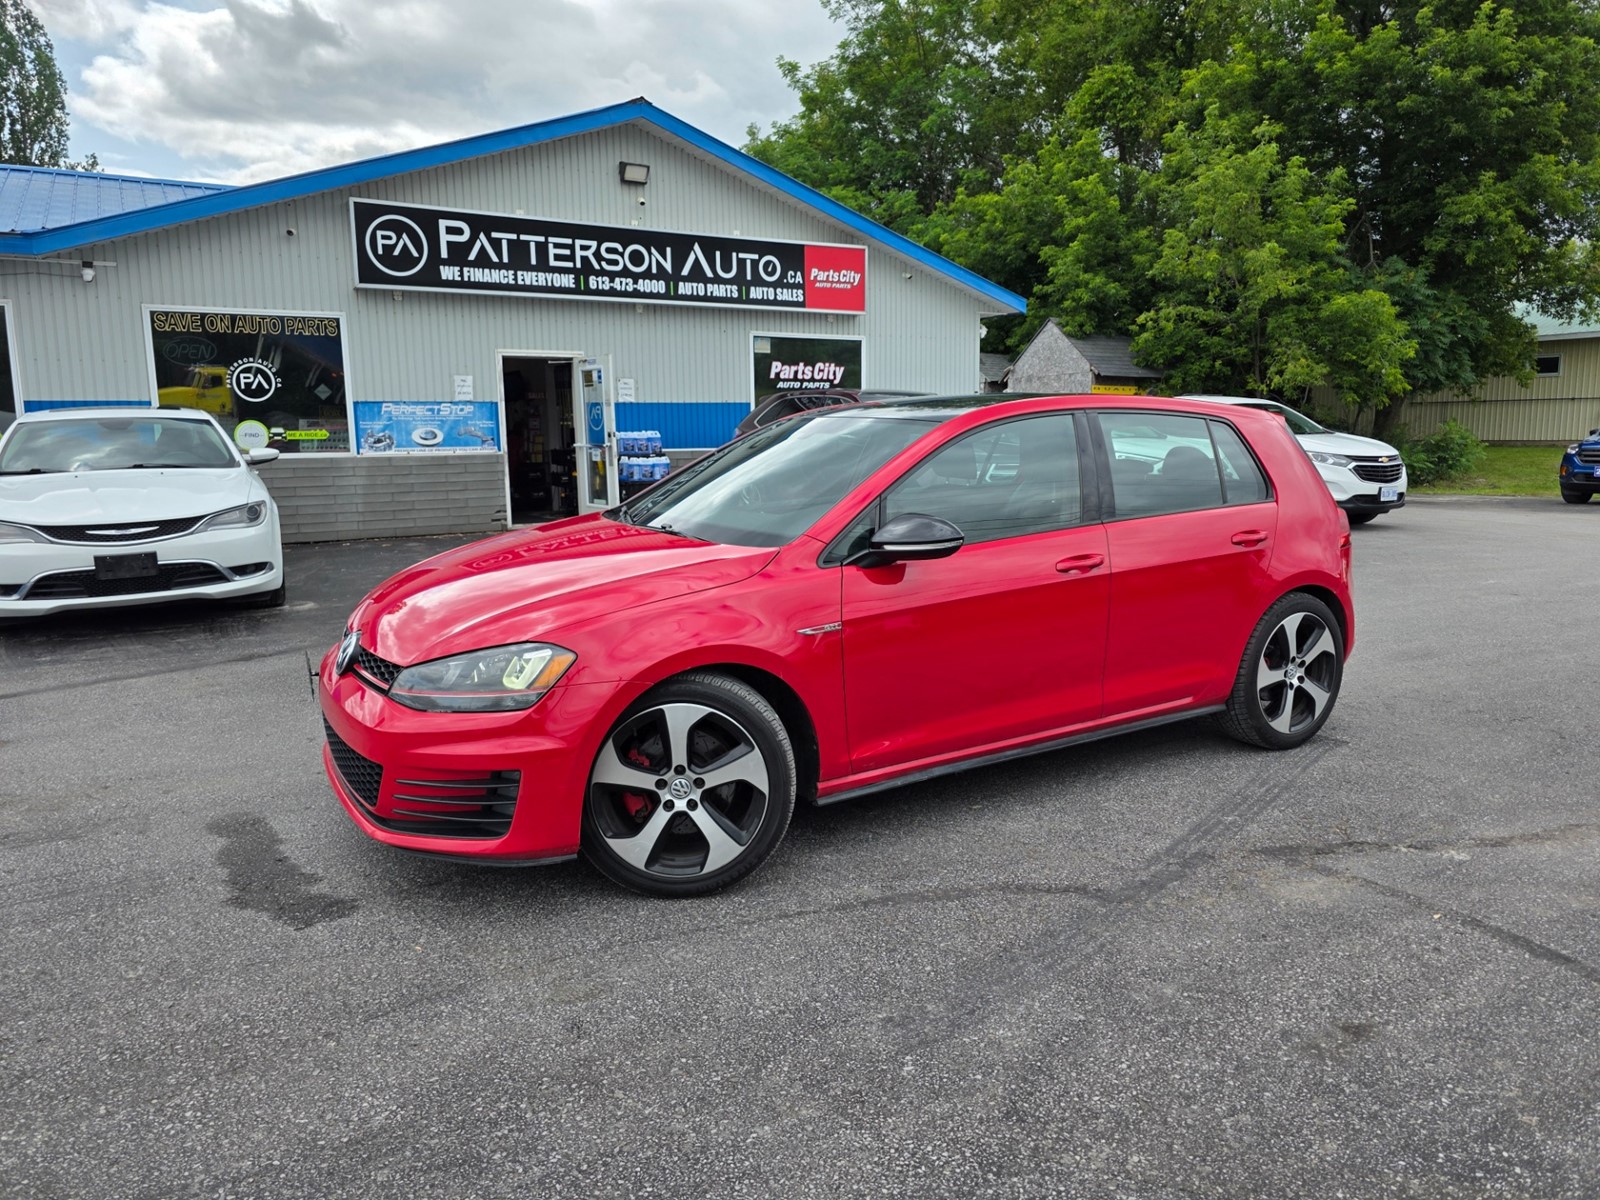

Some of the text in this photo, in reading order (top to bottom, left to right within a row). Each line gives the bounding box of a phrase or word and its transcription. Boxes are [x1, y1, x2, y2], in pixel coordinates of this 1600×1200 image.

[375, 229, 420, 258] PA
[438, 218, 673, 275] PATTERSON
[439, 265, 804, 302] WE FINANCE EVERYONE 613-473-4000 AUTO PARTS AUTO SALES
[153, 312, 338, 337] SAVE ON AUTO PARTS
[166, 343, 212, 359] OPEN
[226, 357, 254, 388] PATTERSON
[240, 373, 270, 389] PA
[776, 381, 831, 389] AUTO PARTS
